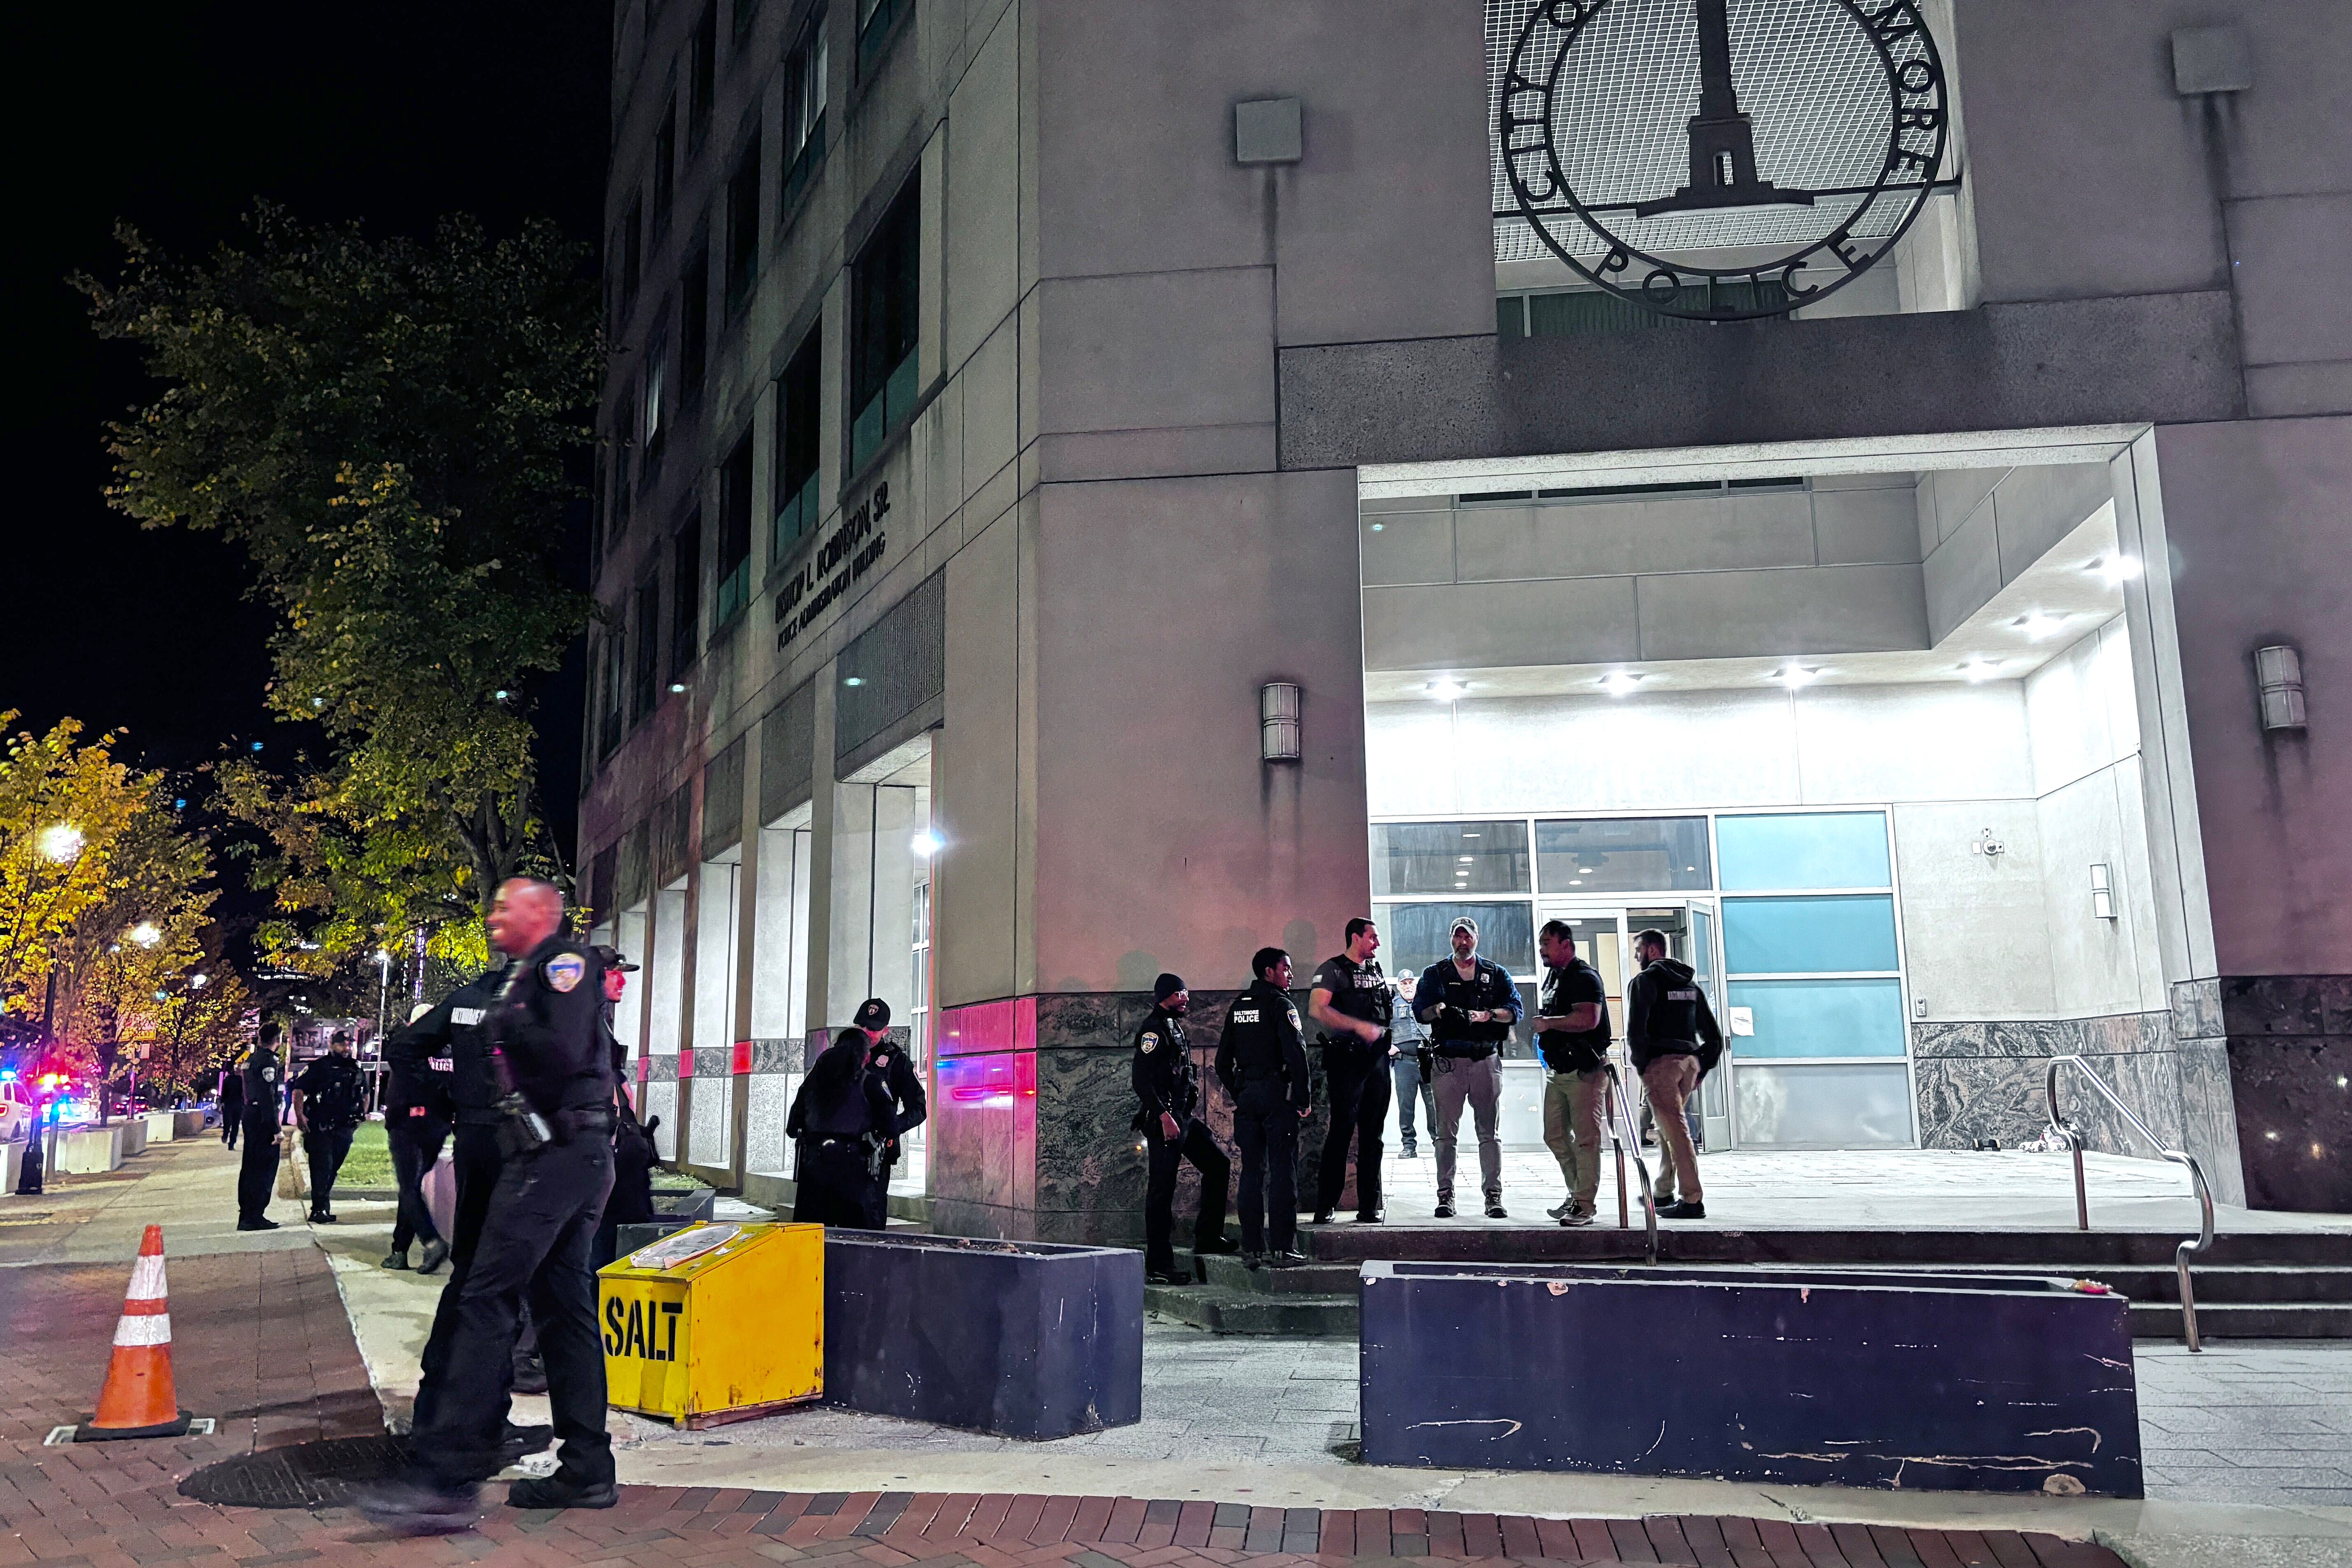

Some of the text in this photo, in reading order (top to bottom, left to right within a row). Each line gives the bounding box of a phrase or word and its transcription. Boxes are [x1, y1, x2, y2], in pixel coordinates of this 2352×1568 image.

[1504, 71, 1558, 203] CITY
[1547, 0, 1583, 28] O
[1594, 231, 1871, 313] POLICE
[1234, 1015, 1259, 1023] POLICE
[605, 1296, 683, 1362] SALT
